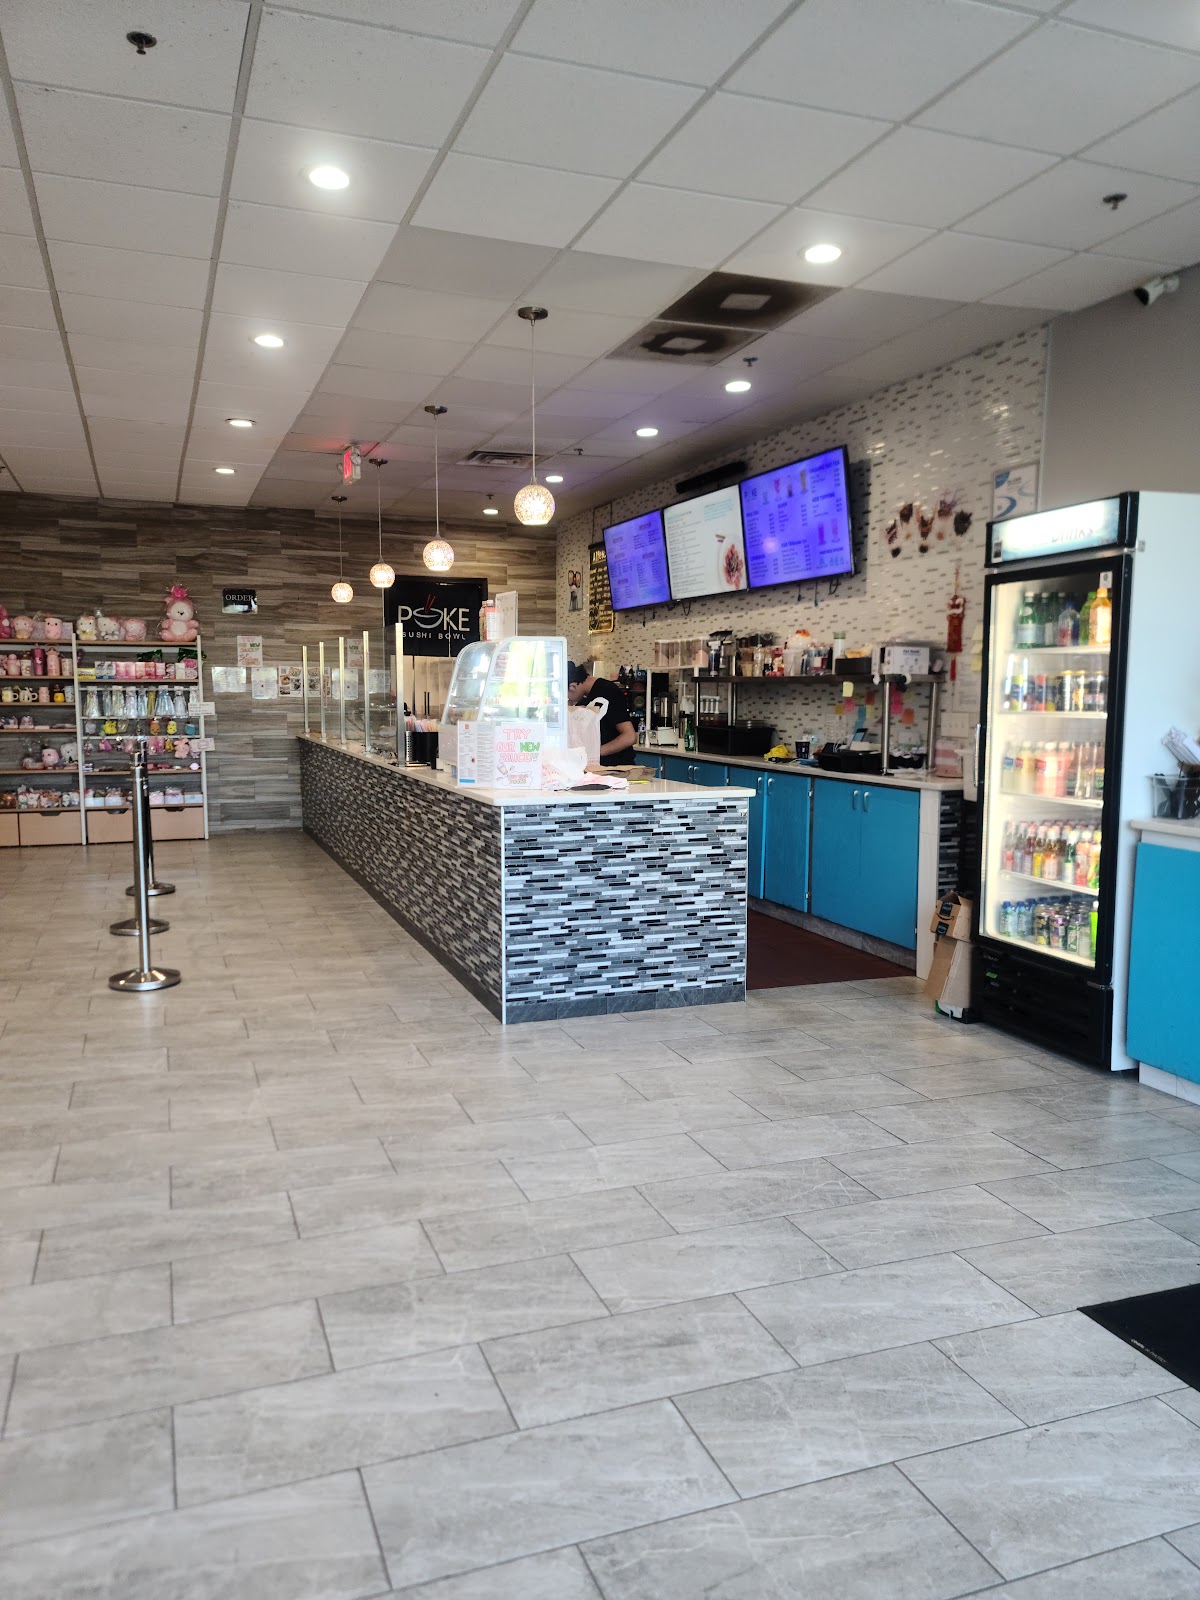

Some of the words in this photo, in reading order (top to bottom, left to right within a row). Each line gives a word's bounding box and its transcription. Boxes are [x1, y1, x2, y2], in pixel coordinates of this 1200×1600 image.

[398, 605, 470, 632] POKE
[402, 631, 432, 639] SUSHI
[438, 632, 466, 640] BOWL
[503, 729, 531, 740] TRY
[496, 741, 516, 753] OUR
[519, 741, 541, 753] NEW
